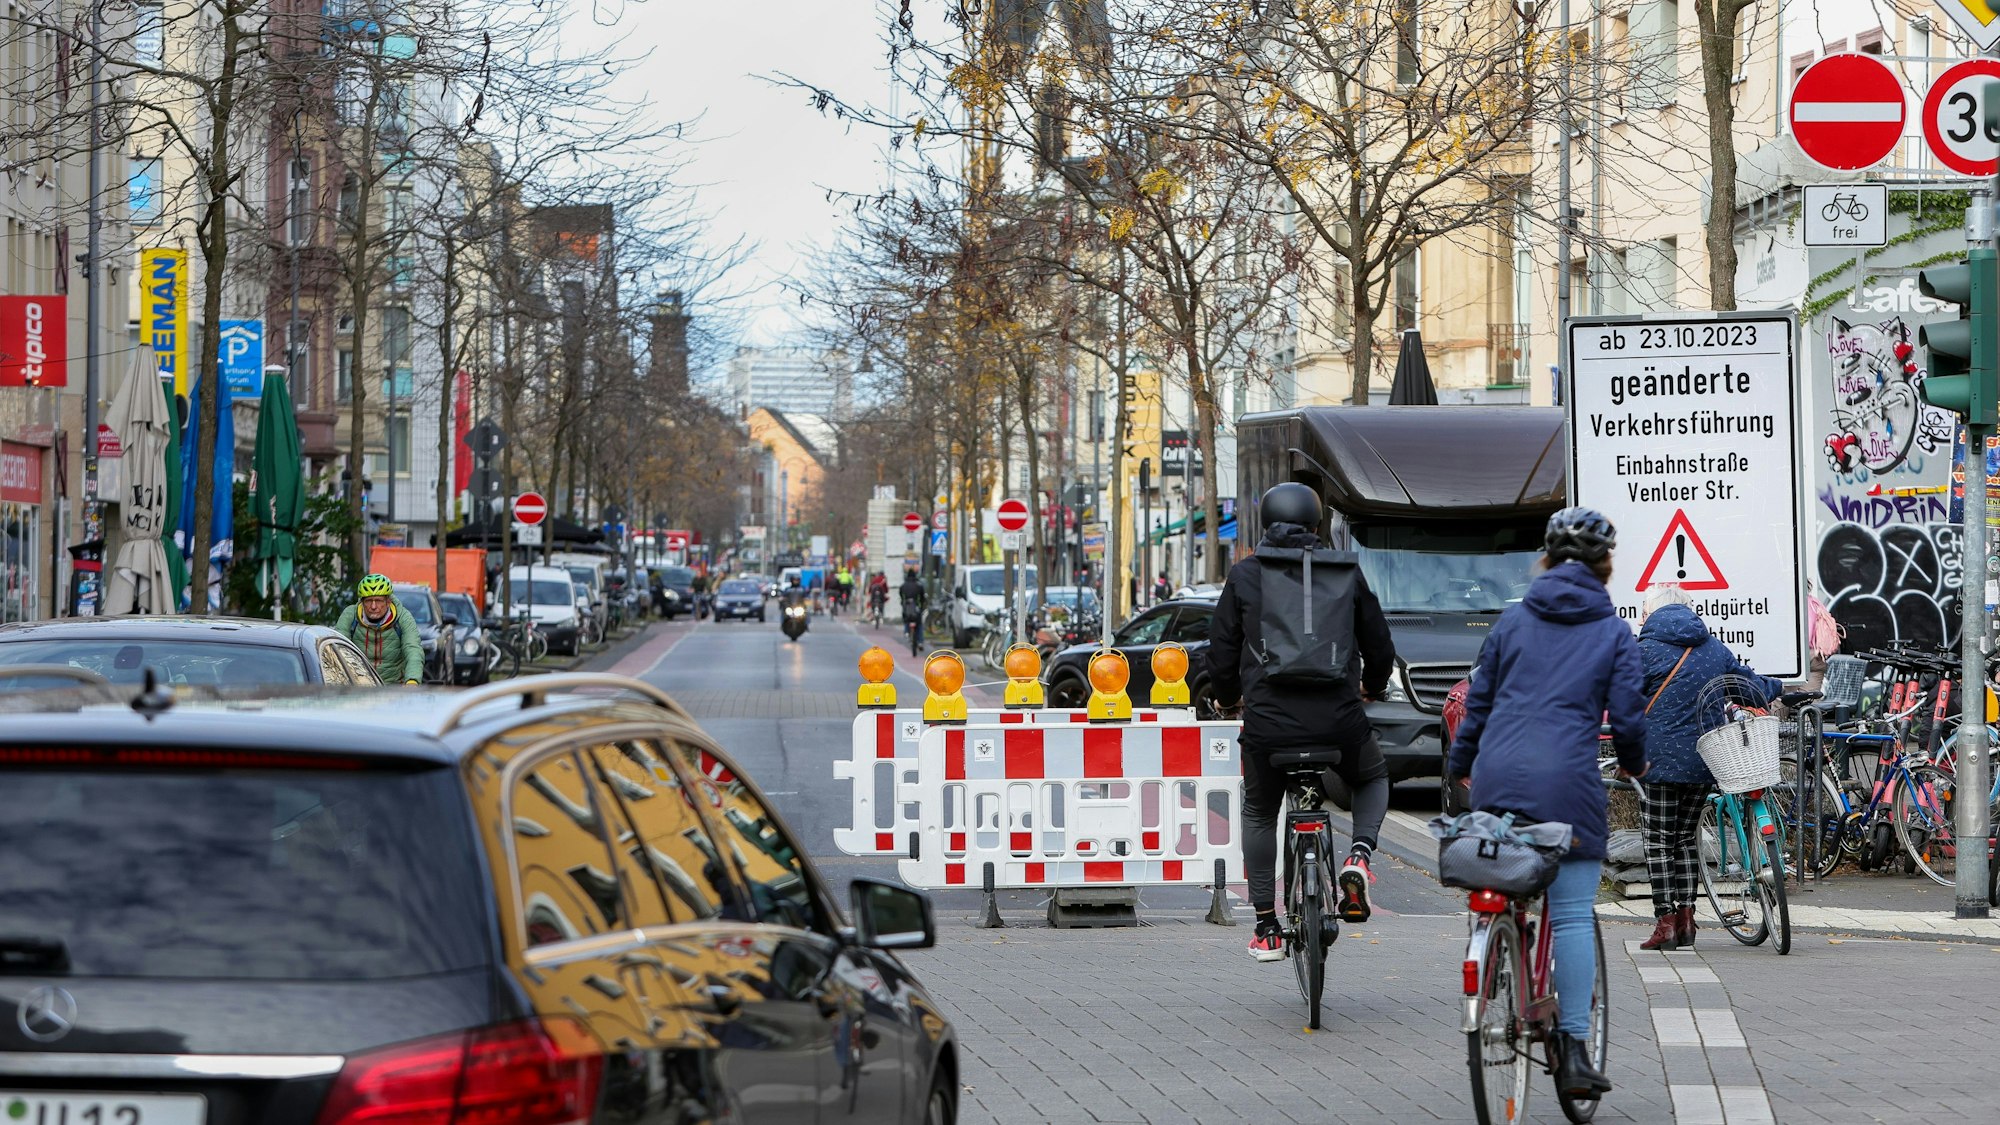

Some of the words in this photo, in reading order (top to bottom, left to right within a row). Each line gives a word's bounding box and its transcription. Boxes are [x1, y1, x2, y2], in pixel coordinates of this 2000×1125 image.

[1947, 91, 2000, 143] 3
[1833, 225, 1858, 239] frei
[152, 258, 176, 386] EEMAN
[20, 302, 47, 379] tipico
[1599, 330, 1626, 350] ab
[1640, 325, 1757, 349] 23.10.2023
[1611, 364, 1750, 405] geänderte
[1590, 410, 1774, 439] Verkehrsführung
[1616, 452, 1749, 475] Einbahnstraße
[1627, 481, 1699, 502] Venloer
[1705, 479, 1740, 500] Str.
[1691, 597, 1769, 620] eldgürtel
[1709, 626, 1754, 648] htung
[1737, 653, 1755, 671] tr.
